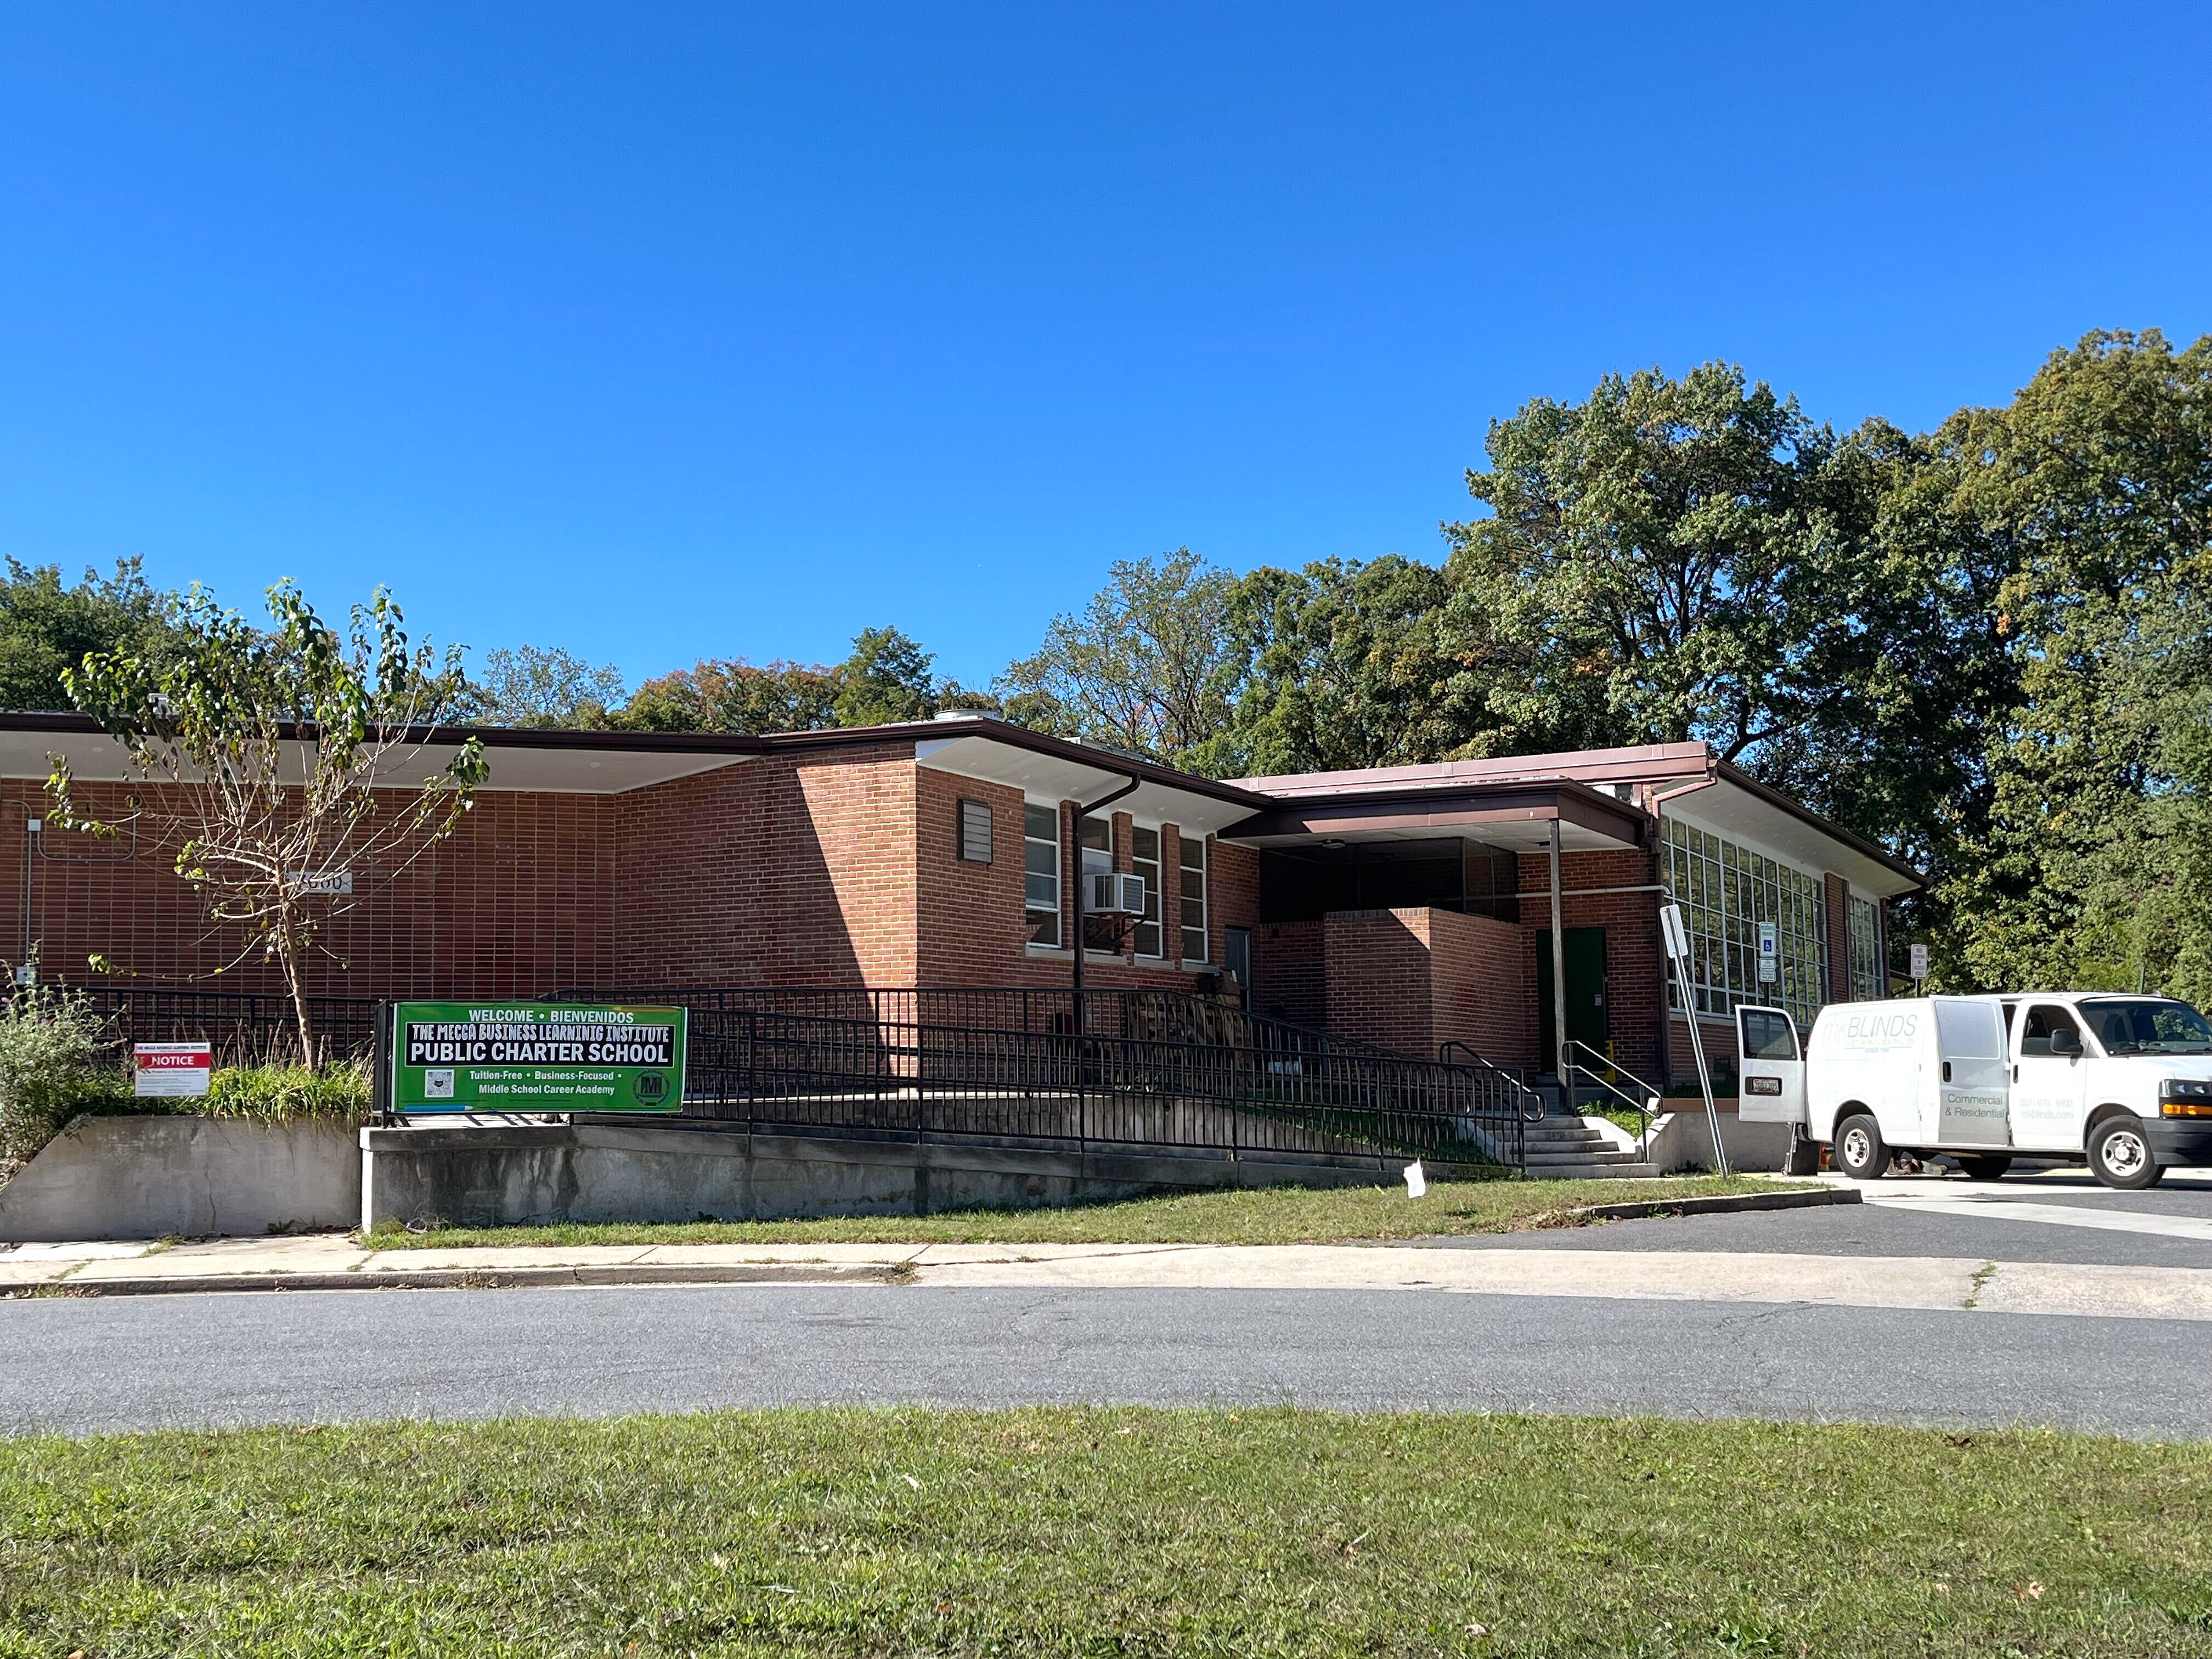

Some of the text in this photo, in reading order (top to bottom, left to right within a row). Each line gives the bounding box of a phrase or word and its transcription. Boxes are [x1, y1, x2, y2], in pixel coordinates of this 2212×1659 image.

[469, 1009, 634, 1024] WELCOME BIENVENIDOS
[412, 1024, 435, 1041] THE
[437, 1024, 477, 1041] MECCA
[479, 1024, 537, 1041] BUSINESS
[605, 1025, 669, 1043] INSTITUTE
[411, 1042, 668, 1063] PUBLIC CHARTER SCHOOL
[151, 1056, 195, 1065] NOTICE
[469, 1070, 614, 1081] Tuition-Free Business-Focused
[478, 1084, 615, 1096] Middle School Career Academy
[1948, 1093, 2002, 1105] Commercial
[1945, 1107, 2005, 1118] & Residential
